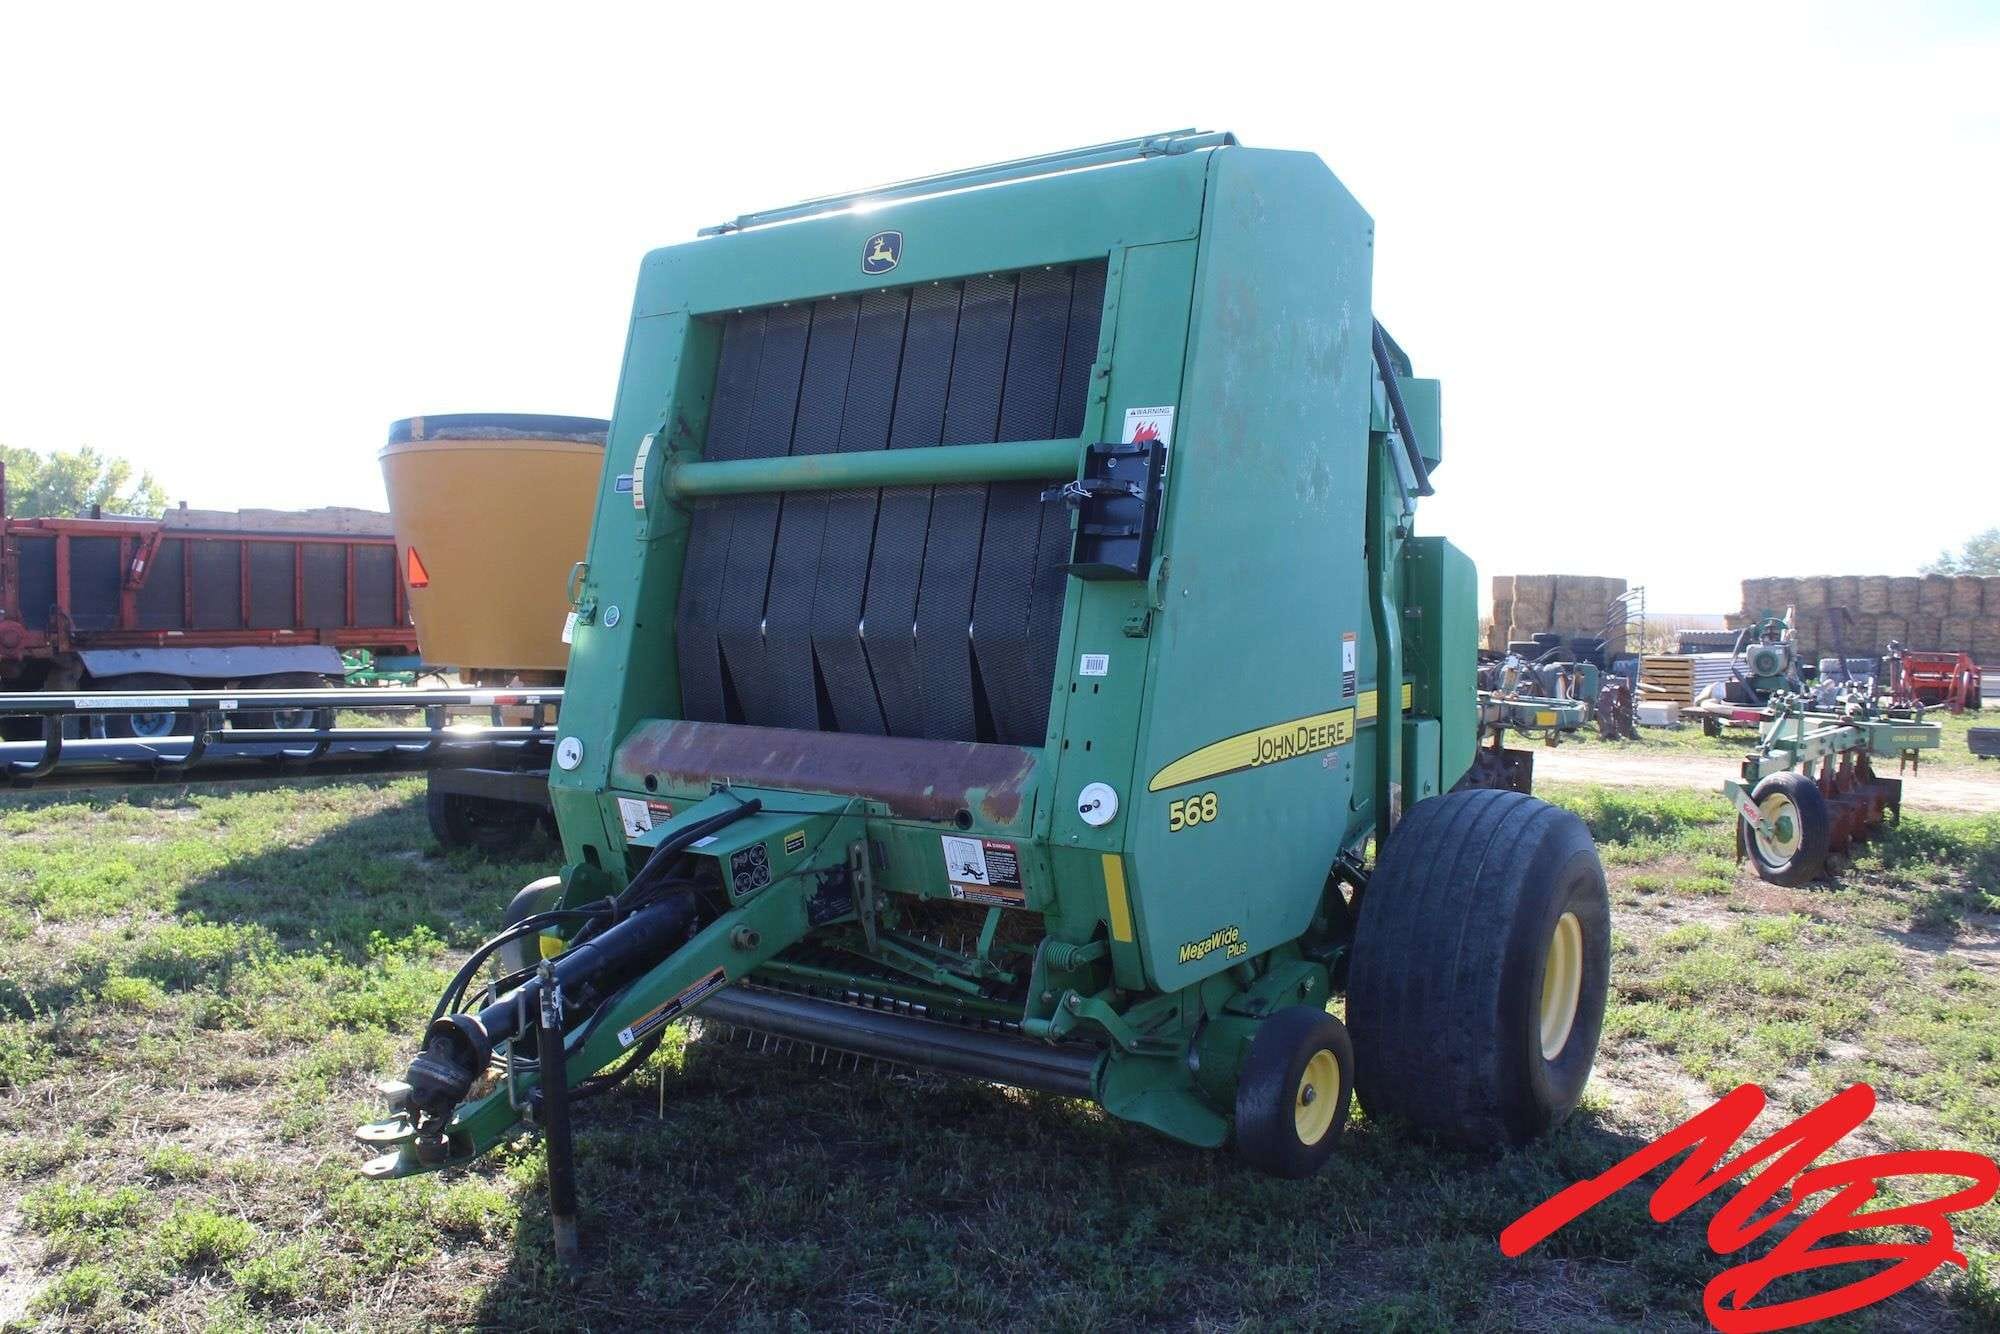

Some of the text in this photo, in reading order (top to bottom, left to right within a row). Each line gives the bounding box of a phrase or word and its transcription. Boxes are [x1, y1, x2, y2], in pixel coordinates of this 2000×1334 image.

[1252, 734, 1295, 763] JOHN
[1297, 722, 1344, 751] DEERE
[1169, 791, 1217, 832] 568
[1179, 926, 1239, 964] MegaWide
[1226, 941, 1248, 960] Plus
